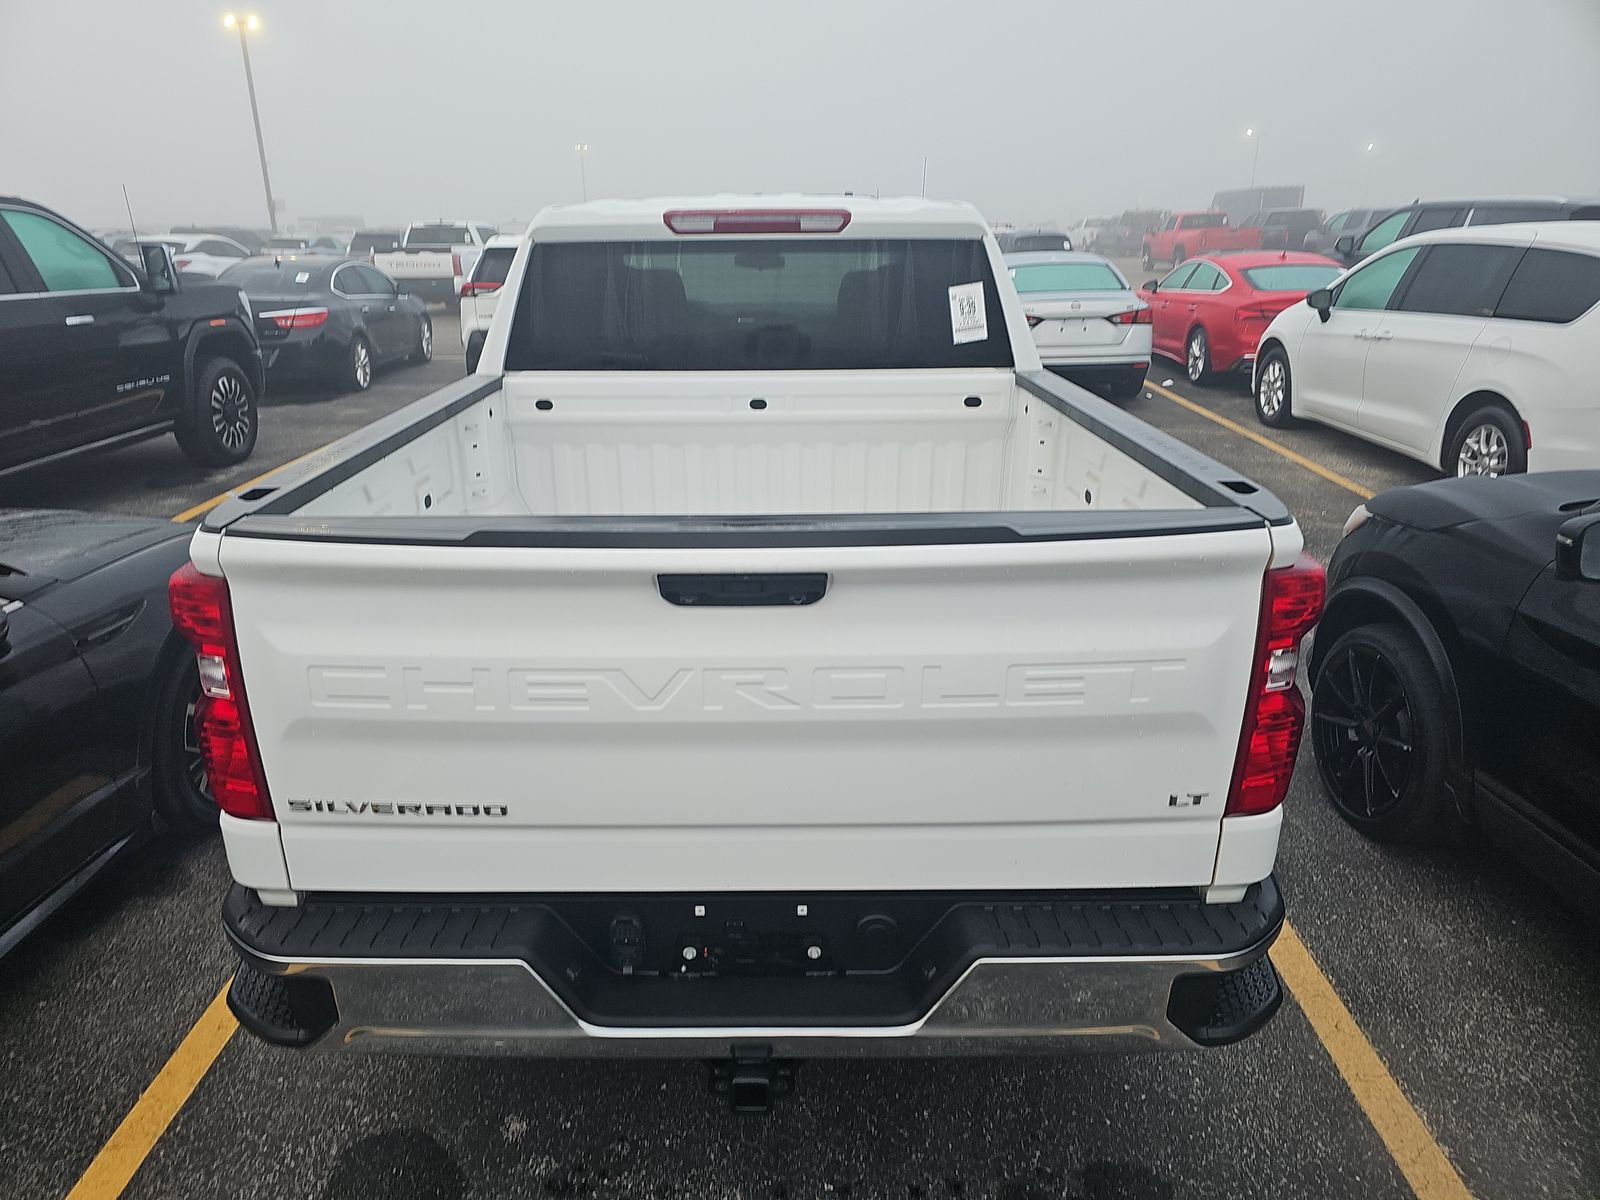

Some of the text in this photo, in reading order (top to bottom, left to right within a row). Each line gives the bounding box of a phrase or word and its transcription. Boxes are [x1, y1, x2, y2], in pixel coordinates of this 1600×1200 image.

[306, 658, 1188, 711] CHEVROLET
[287, 798, 509, 817] SILVERADO
[1168, 793, 1210, 807] LT
